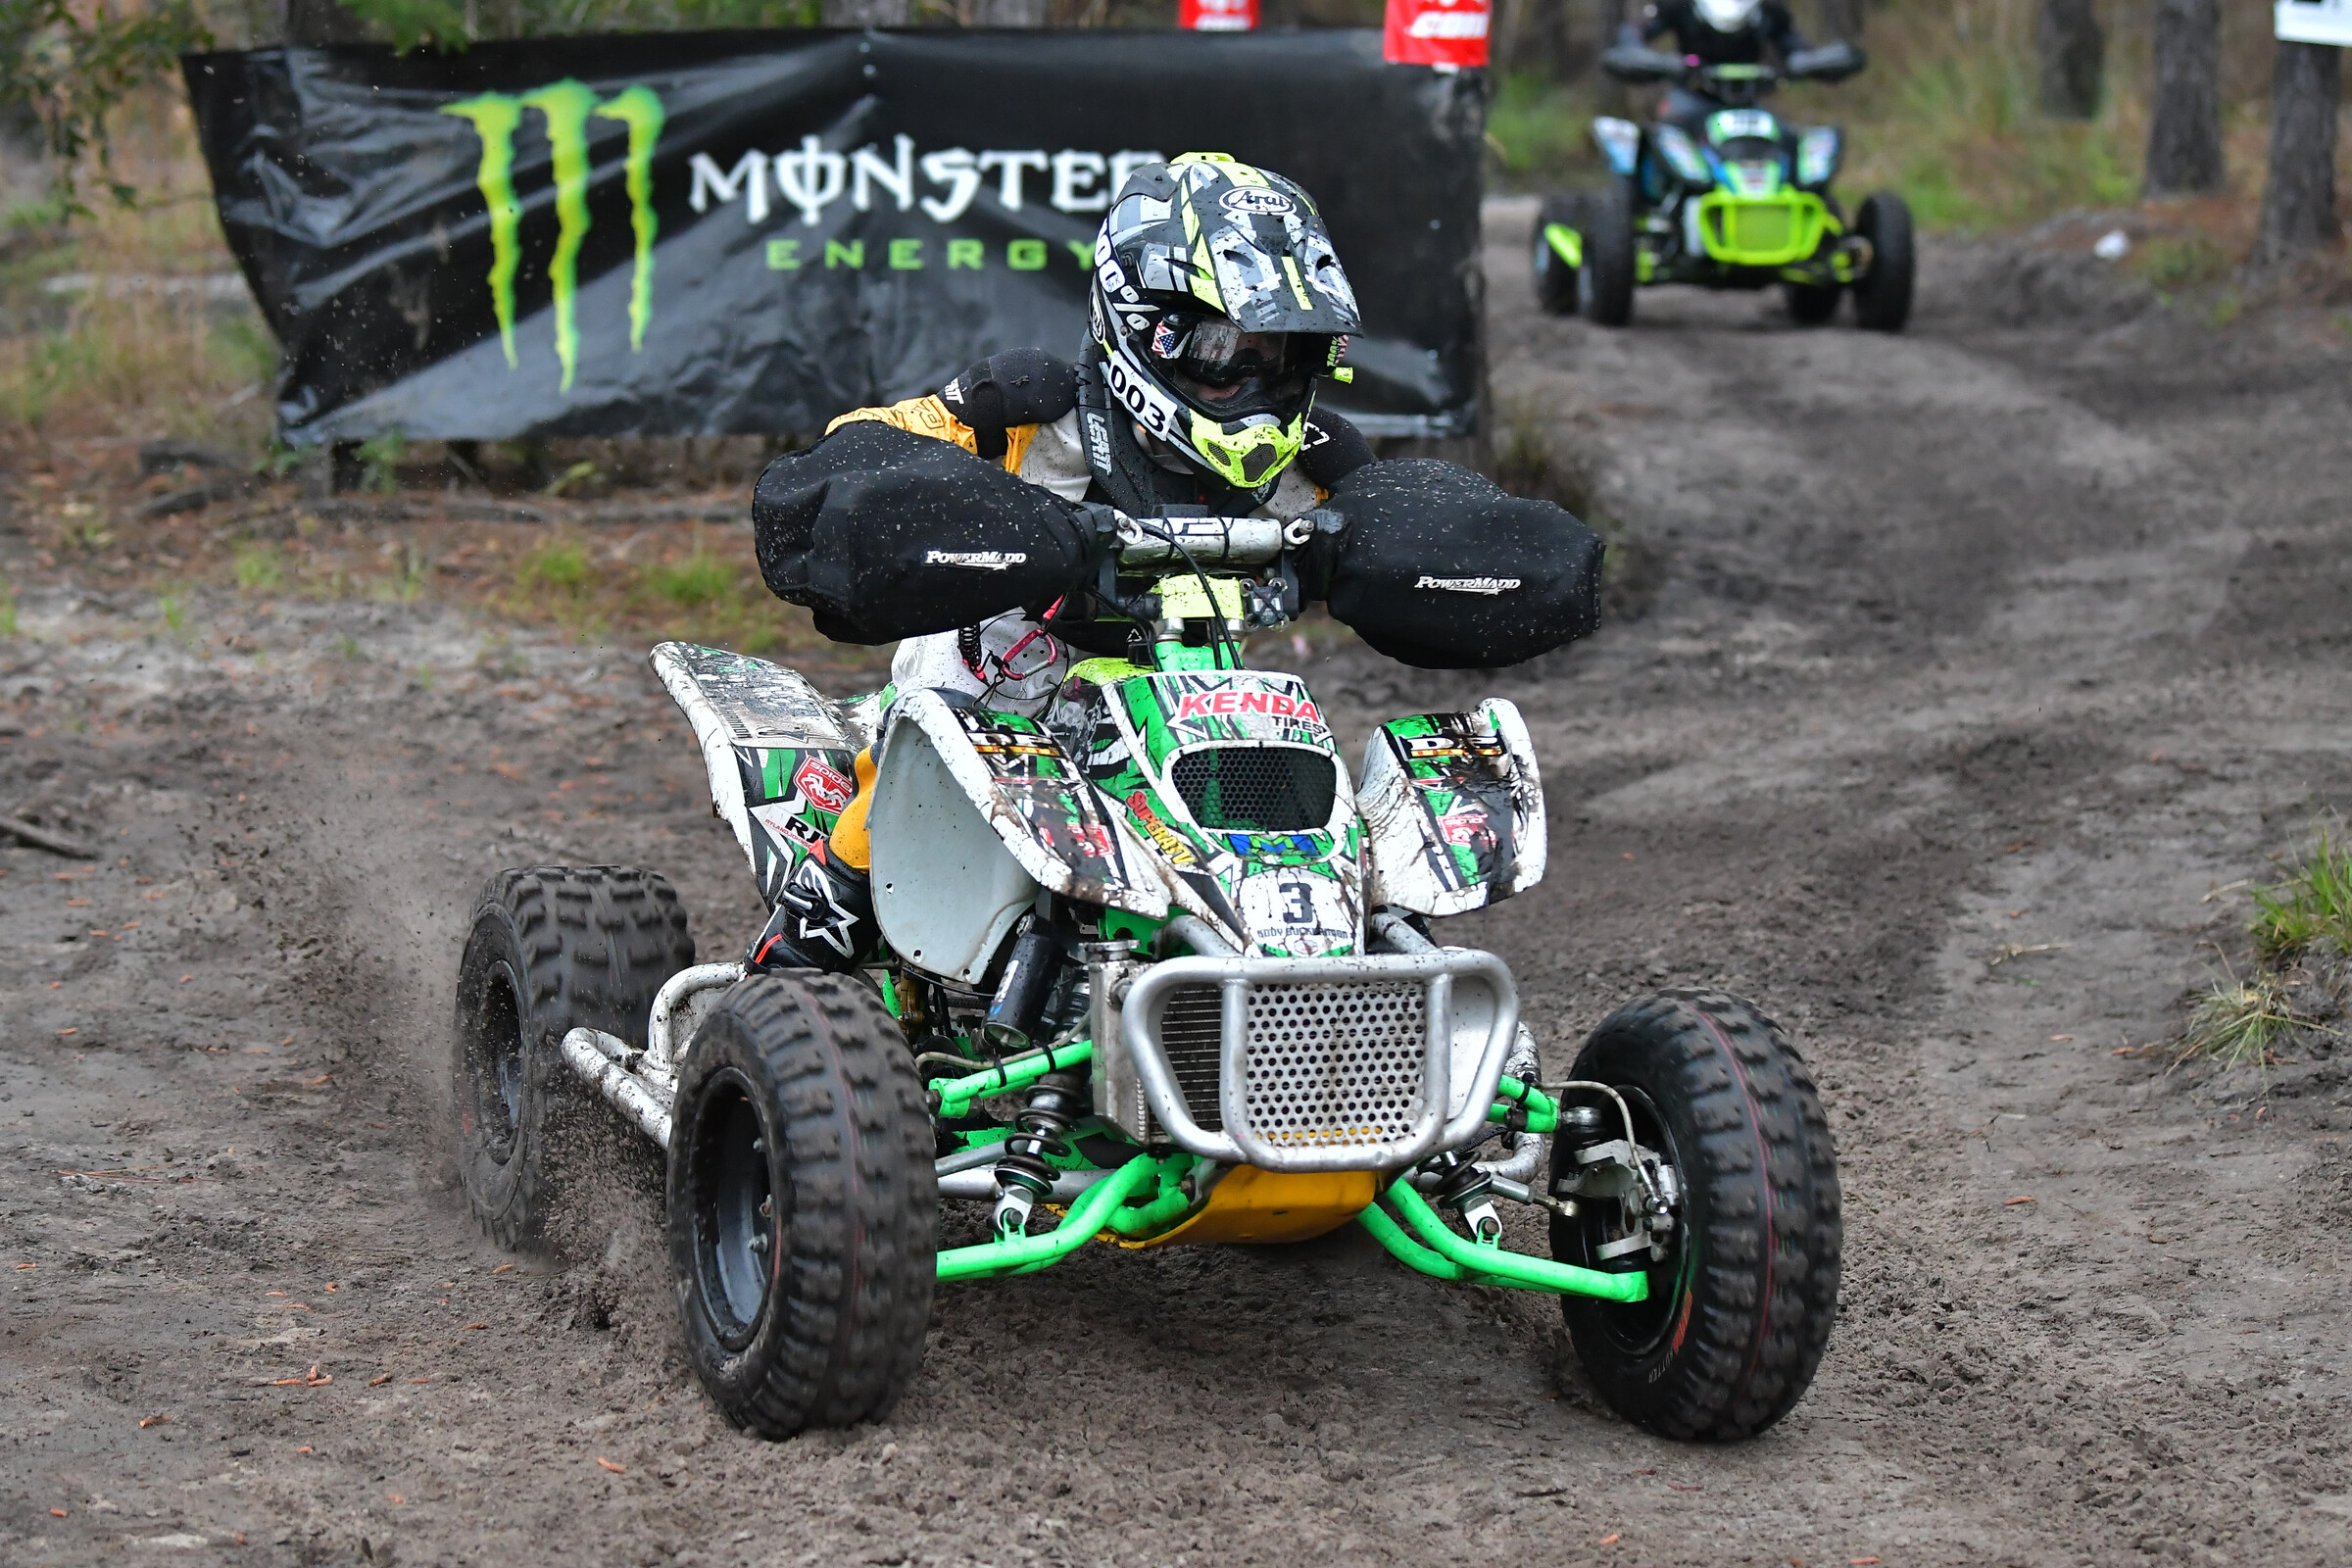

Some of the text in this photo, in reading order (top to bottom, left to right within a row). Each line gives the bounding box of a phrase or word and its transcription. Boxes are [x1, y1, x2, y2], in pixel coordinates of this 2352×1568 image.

[1230, 190, 1287, 208] Arai
[765, 239, 1097, 270] ENERGY
[1110, 364, 1166, 434] 003
[1179, 691, 1321, 724] KENDA
[1271, 715, 1323, 735] TIRES
[1279, 882, 1313, 923] 3
